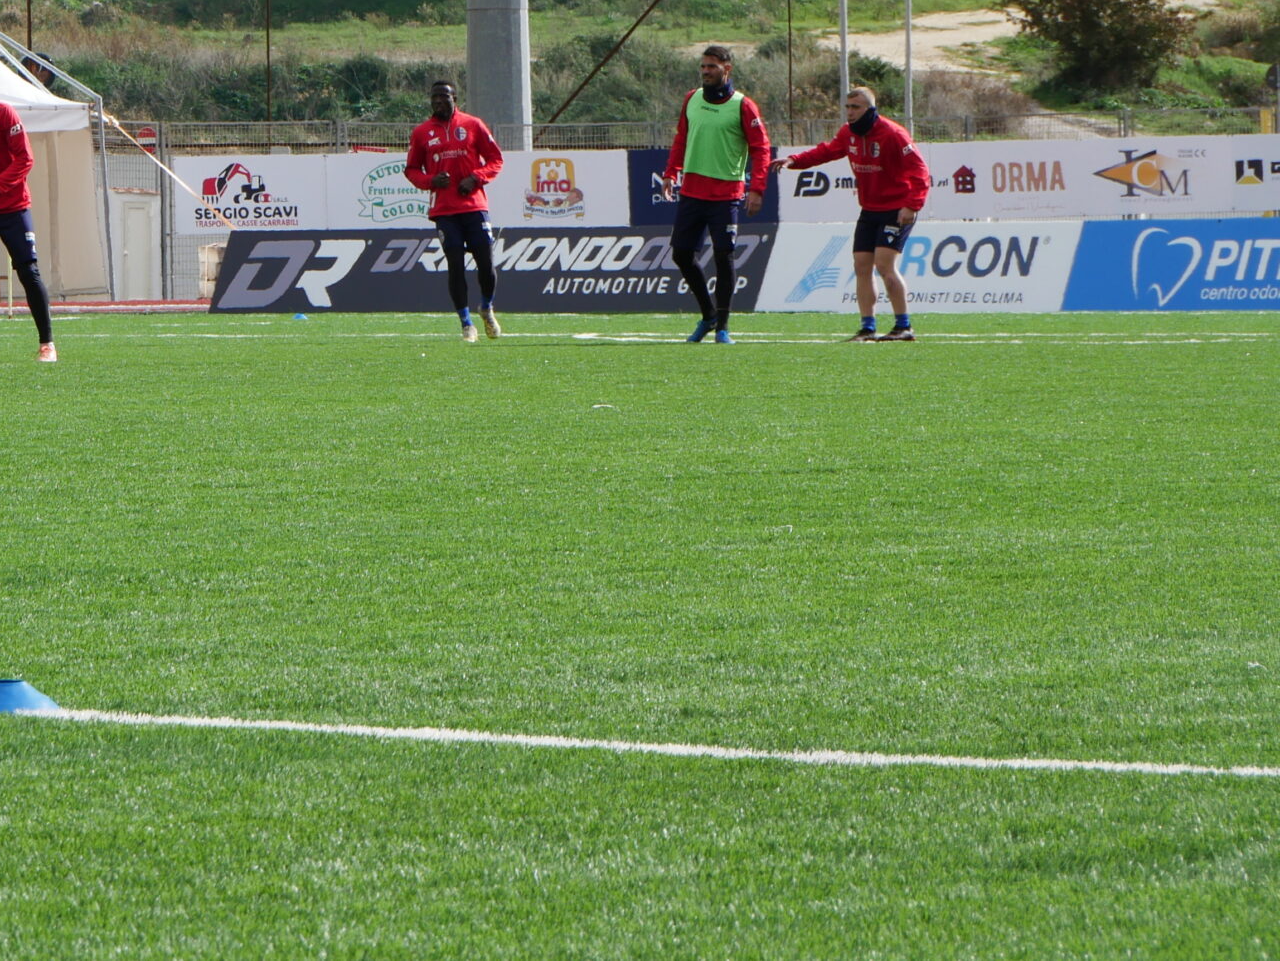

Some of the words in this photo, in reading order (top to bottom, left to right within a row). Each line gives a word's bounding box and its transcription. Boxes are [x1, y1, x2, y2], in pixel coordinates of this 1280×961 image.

[536, 174, 571, 193] ima
[992, 160, 1066, 193] ORMA
[368, 186, 396, 195] Frutta
[194, 206, 249, 220] SERGIO
[253, 205, 298, 219] SCAVI
[382, 203, 429, 219] COLOM
[237, 219, 258, 227] CASSE
[259, 218, 299, 227] SCARRABILI
[1204, 239, 1280, 281] PIT
[217, 239, 367, 309] DR
[543, 276, 671, 295] AUTOMOTIVE
[677, 276, 748, 295] GOP
[1200, 285, 1247, 300] centro
[953, 291, 977, 304] DEL
[982, 291, 1024, 304] CLIMA
